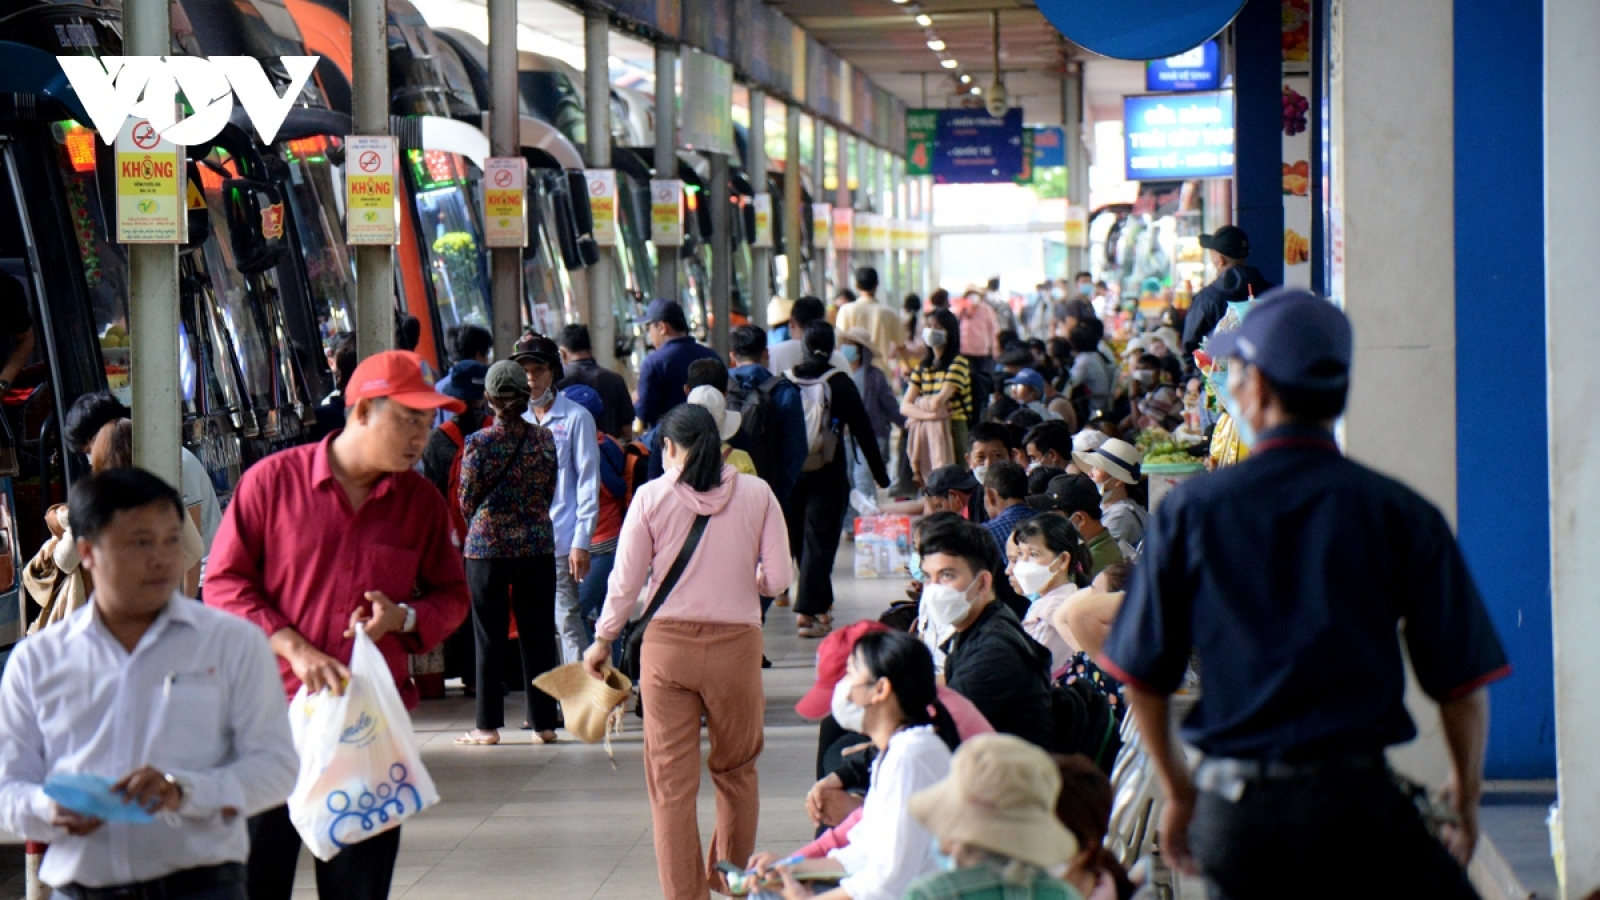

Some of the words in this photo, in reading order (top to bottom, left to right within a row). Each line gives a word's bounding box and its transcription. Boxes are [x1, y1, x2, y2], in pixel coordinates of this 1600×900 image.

[122, 154, 174, 180] KHÔNG
[911, 142, 928, 169] 4
[351, 176, 391, 197] KHÔNG
